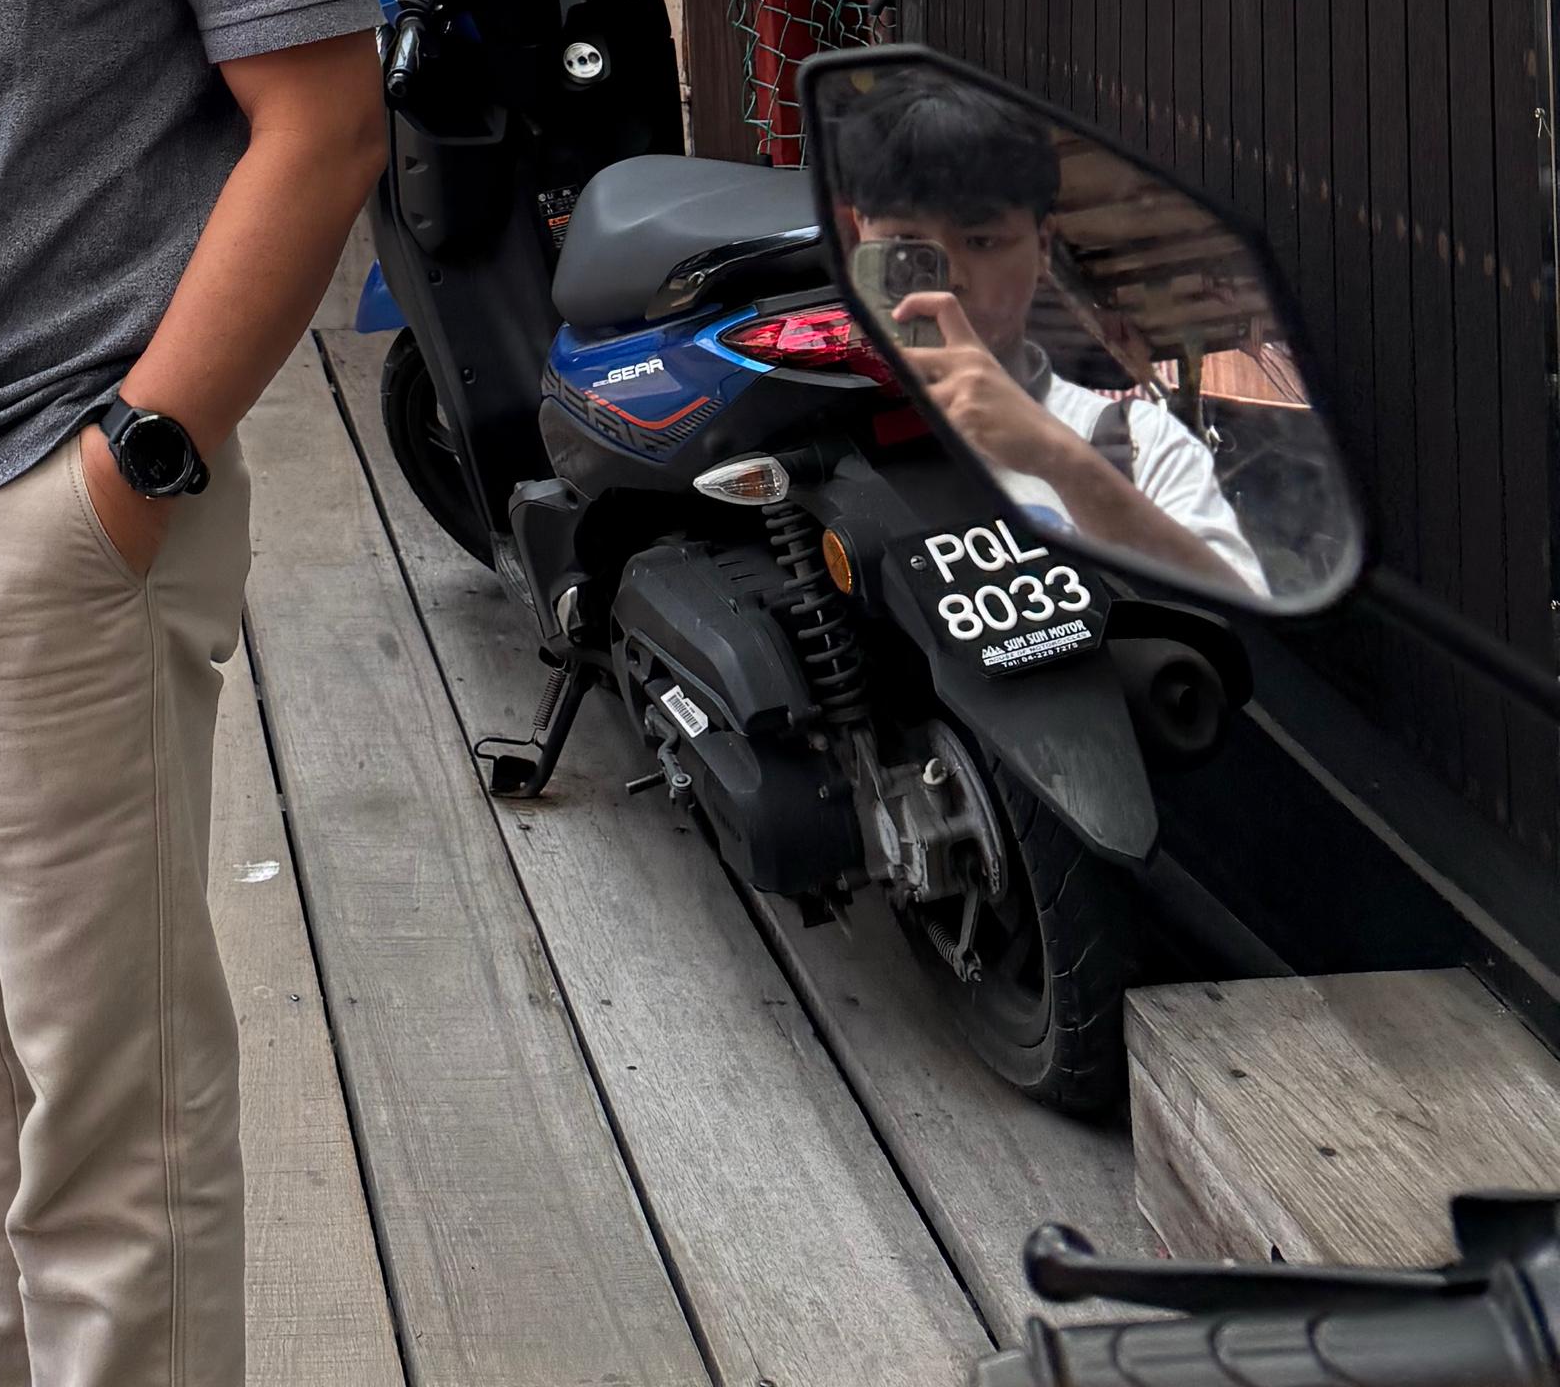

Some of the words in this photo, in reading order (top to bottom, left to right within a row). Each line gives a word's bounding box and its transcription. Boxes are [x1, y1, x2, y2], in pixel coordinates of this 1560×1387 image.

[607, 358, 665, 384] GEAR
[924, 519, 1050, 583] PQL
[938, 565, 1091, 641] 8033
[1048, 619, 1087, 639] MOTOR
